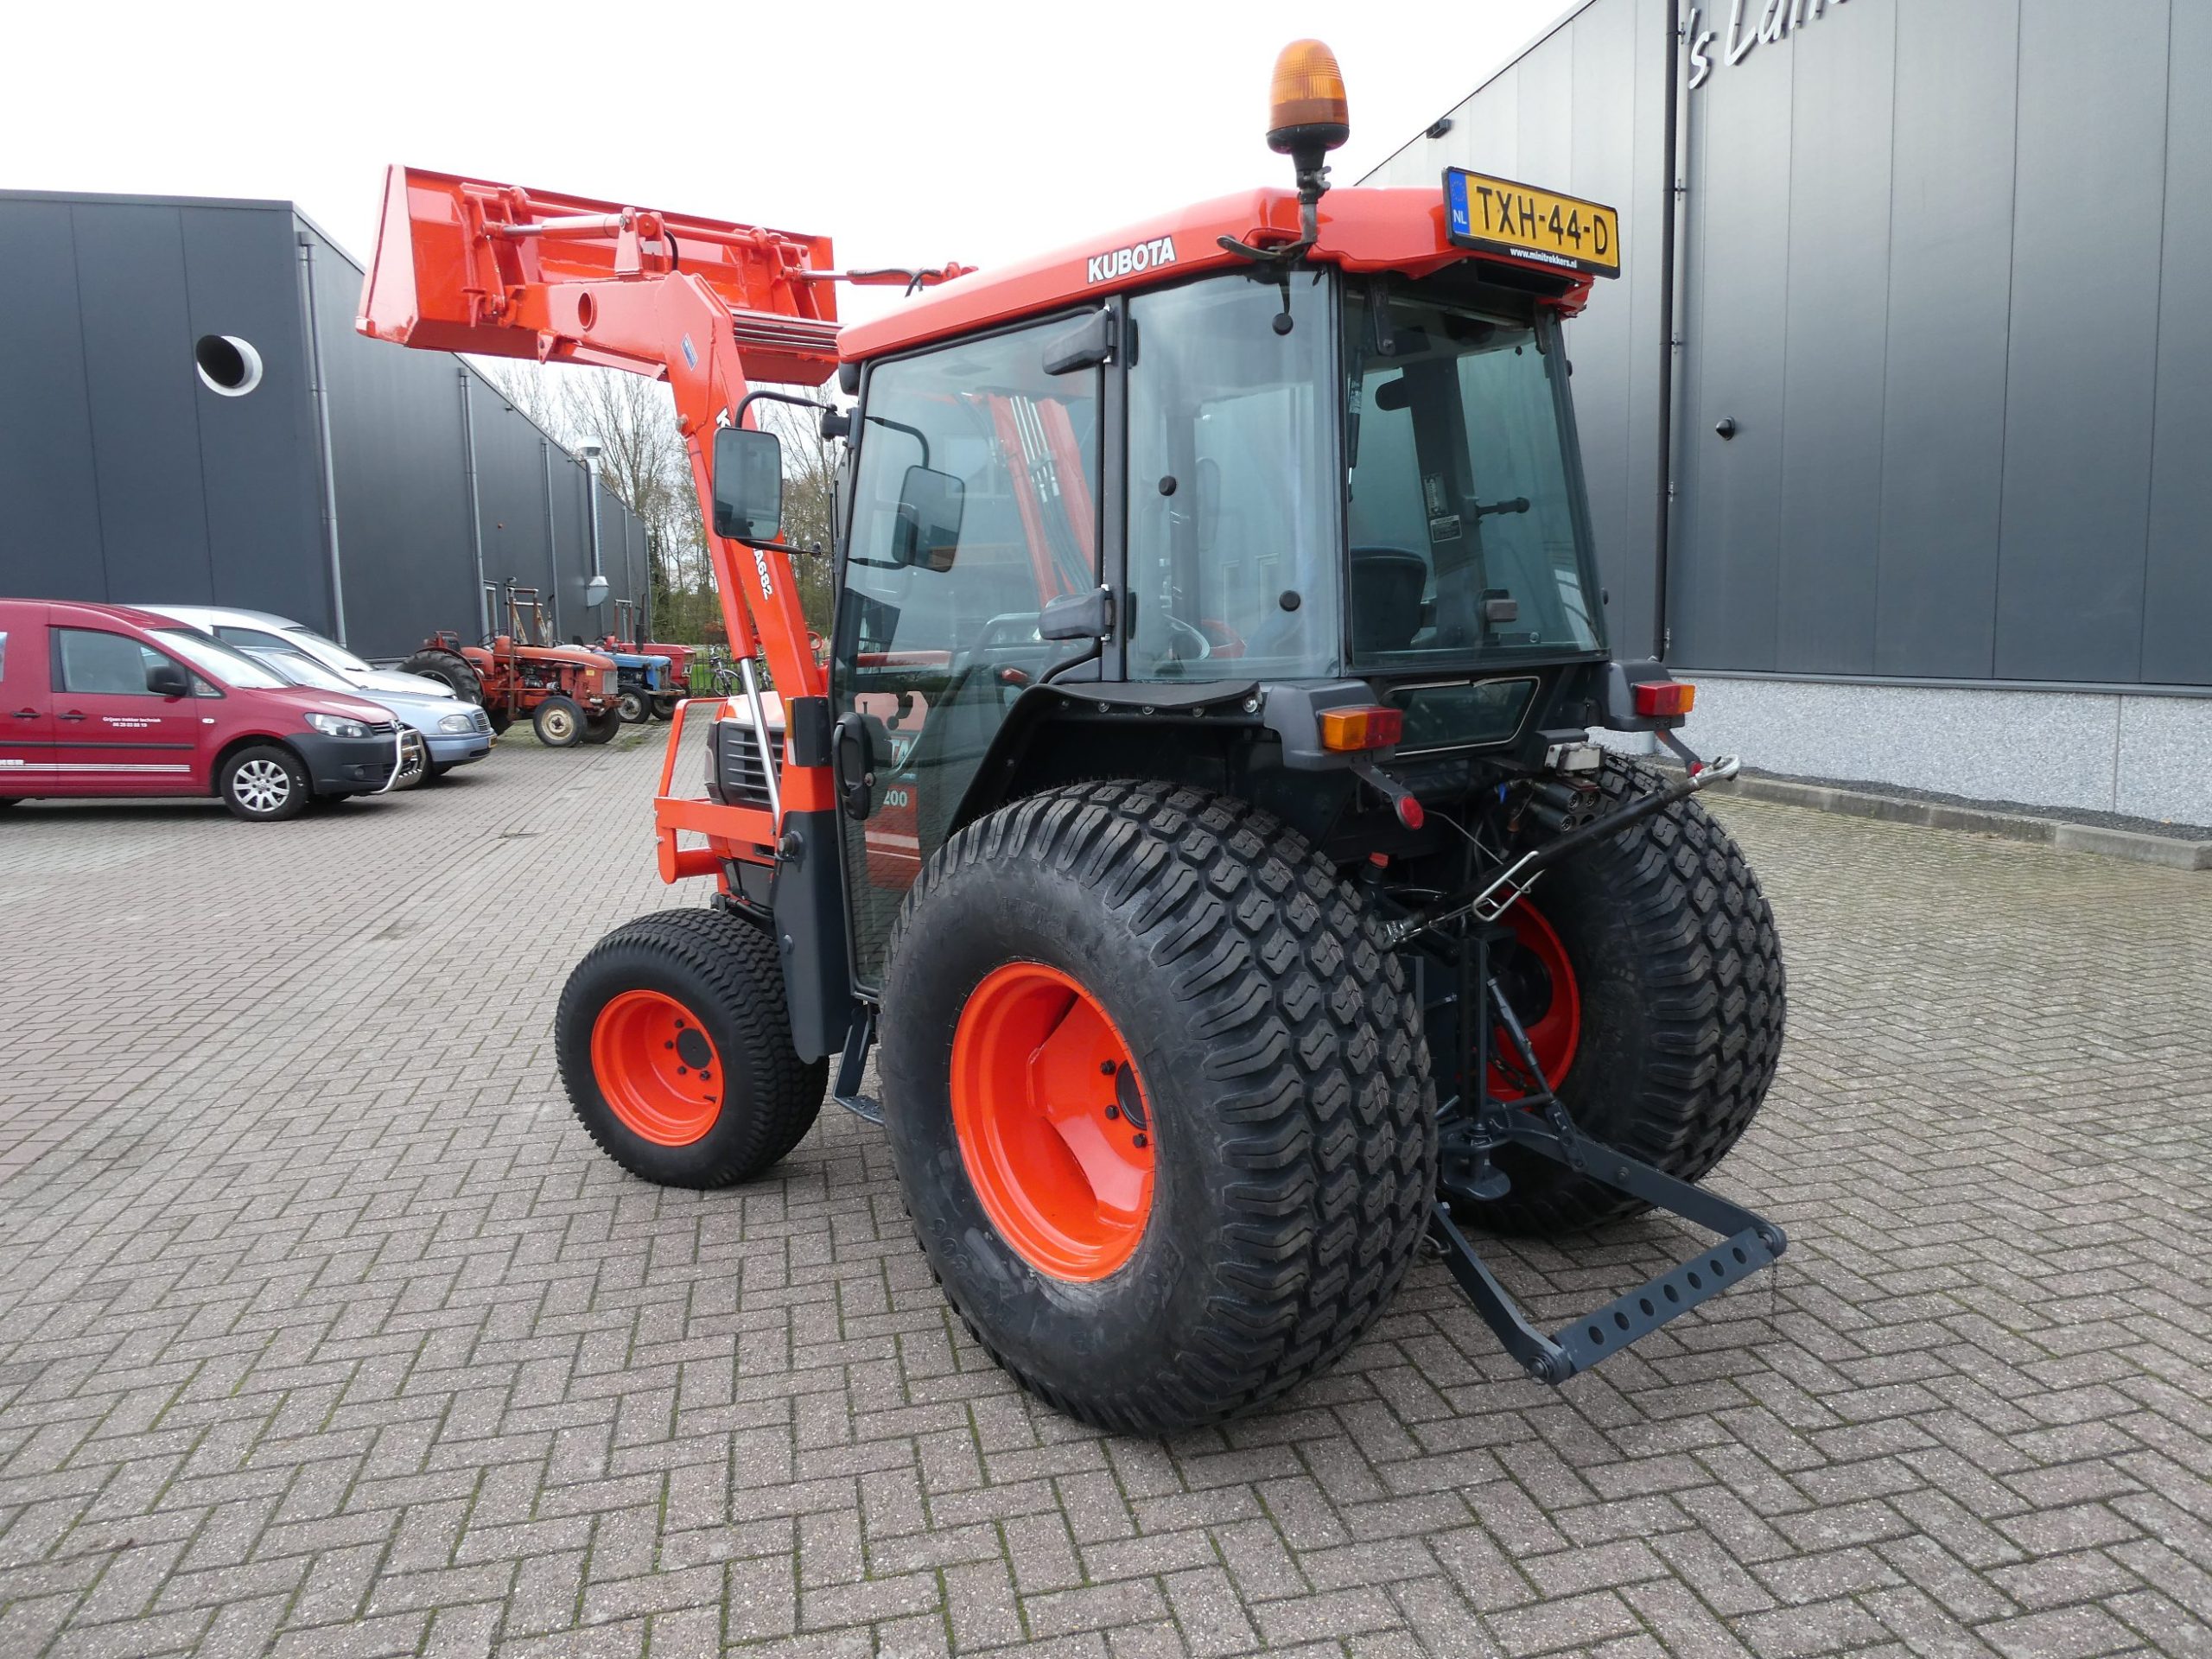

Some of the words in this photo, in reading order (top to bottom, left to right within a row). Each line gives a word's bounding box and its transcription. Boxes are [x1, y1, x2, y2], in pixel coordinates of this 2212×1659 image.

[1452, 211, 1467, 225] NL
[1476, 186, 1608, 255] TXH-44-D
[1087, 236, 1176, 283] KUBOTA
[1510, 248, 1578, 269] www.minitrekkers.nl
[753, 548, 773, 601] A682
